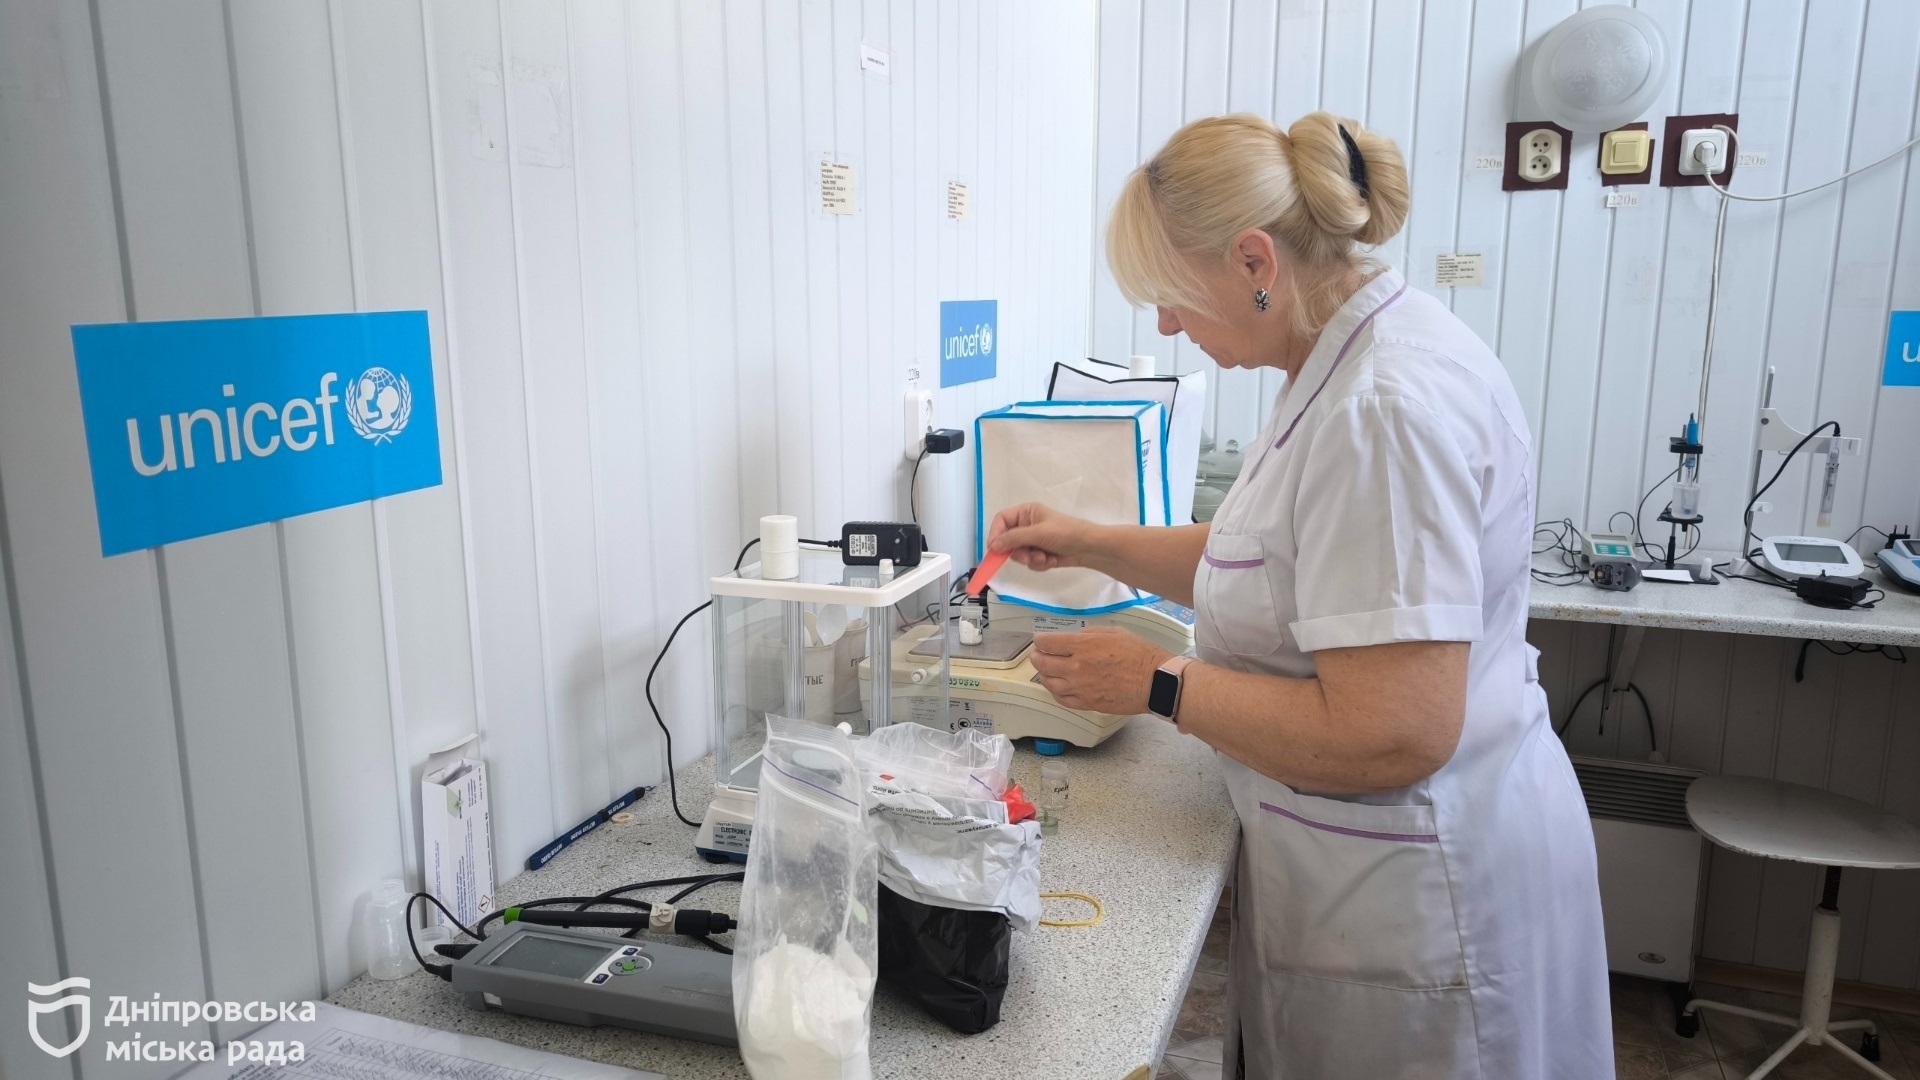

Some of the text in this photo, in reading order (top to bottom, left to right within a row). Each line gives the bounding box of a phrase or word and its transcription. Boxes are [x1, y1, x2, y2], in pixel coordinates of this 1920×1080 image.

[945, 324, 980, 360] unicef
[126, 371, 339, 477] unicef
[804, 675, 824, 686] ТЫЕ
